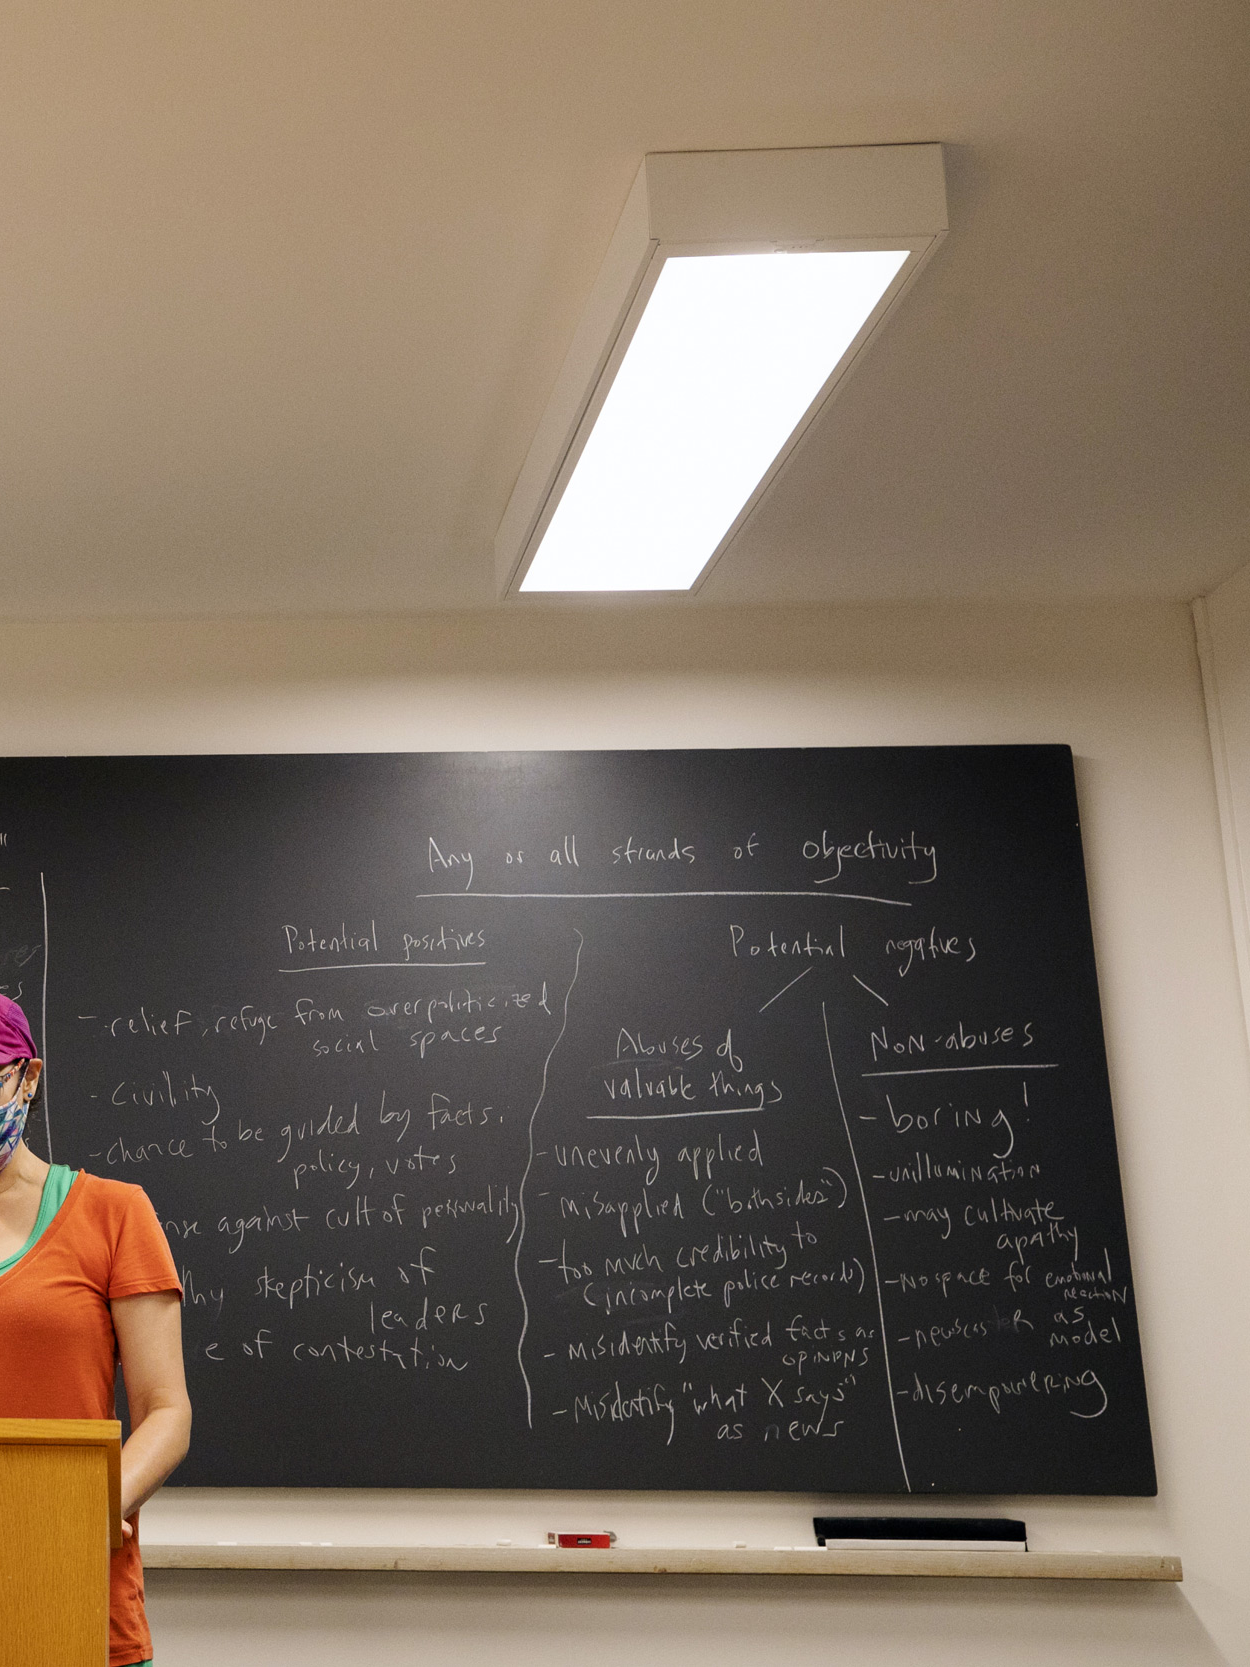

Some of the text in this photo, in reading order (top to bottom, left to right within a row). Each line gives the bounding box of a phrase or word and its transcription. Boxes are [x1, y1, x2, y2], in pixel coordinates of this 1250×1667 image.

[429, 836, 474, 891] Any
[505, 846, 525, 868] or
[550, 834, 579, 867] all
[612, 838, 696, 864] strands
[733, 833, 760, 860] of
[281, 919, 487, 961] Potential positives
[730, 923, 976, 978] Potential negatives
[215, 1004, 278, 1046] refuge
[295, 998, 344, 1026] from
[312, 1025, 503, 1059] social spaces
[615, 1027, 704, 1061] Abuses
[603, 1067, 783, 1109] valuable things
[203, 1121, 228, 1153] to
[237, 1118, 265, 1143] be
[277, 1104, 362, 1163] guided
[379, 1090, 411, 1143] by
[386, 1149, 457, 1175] votes
[677, 1131, 764, 1181] applied
[217, 1205, 310, 1255] against
[324, 1193, 375, 1230] cult
[381, 1193, 406, 1227] of
[963, 1196, 1065, 1227] cultivate
[604, 1243, 664, 1273] much
[675, 1232, 788, 1271] credibility
[791, 1220, 818, 1250] to
[995, 1221, 1079, 1266] apathy
[254, 1261, 376, 1310] skepticism
[398, 1245, 437, 1287] of
[723, 1267, 781, 1309] police
[935, 1267, 991, 1298] space
[1003, 1259, 1032, 1293] for
[370, 1298, 488, 1334] leaders
[695, 1317, 773, 1351] verified
[785, 1313, 847, 1343] facts
[854, 1327, 876, 1341] as
[1049, 1316, 1122, 1348] model
[1053, 1305, 1085, 1326] as
[241, 1327, 273, 1360] of
[292, 1334, 469, 1373] contestation
[760, 1376, 785, 1409] X
[716, 1422, 744, 1441] as
